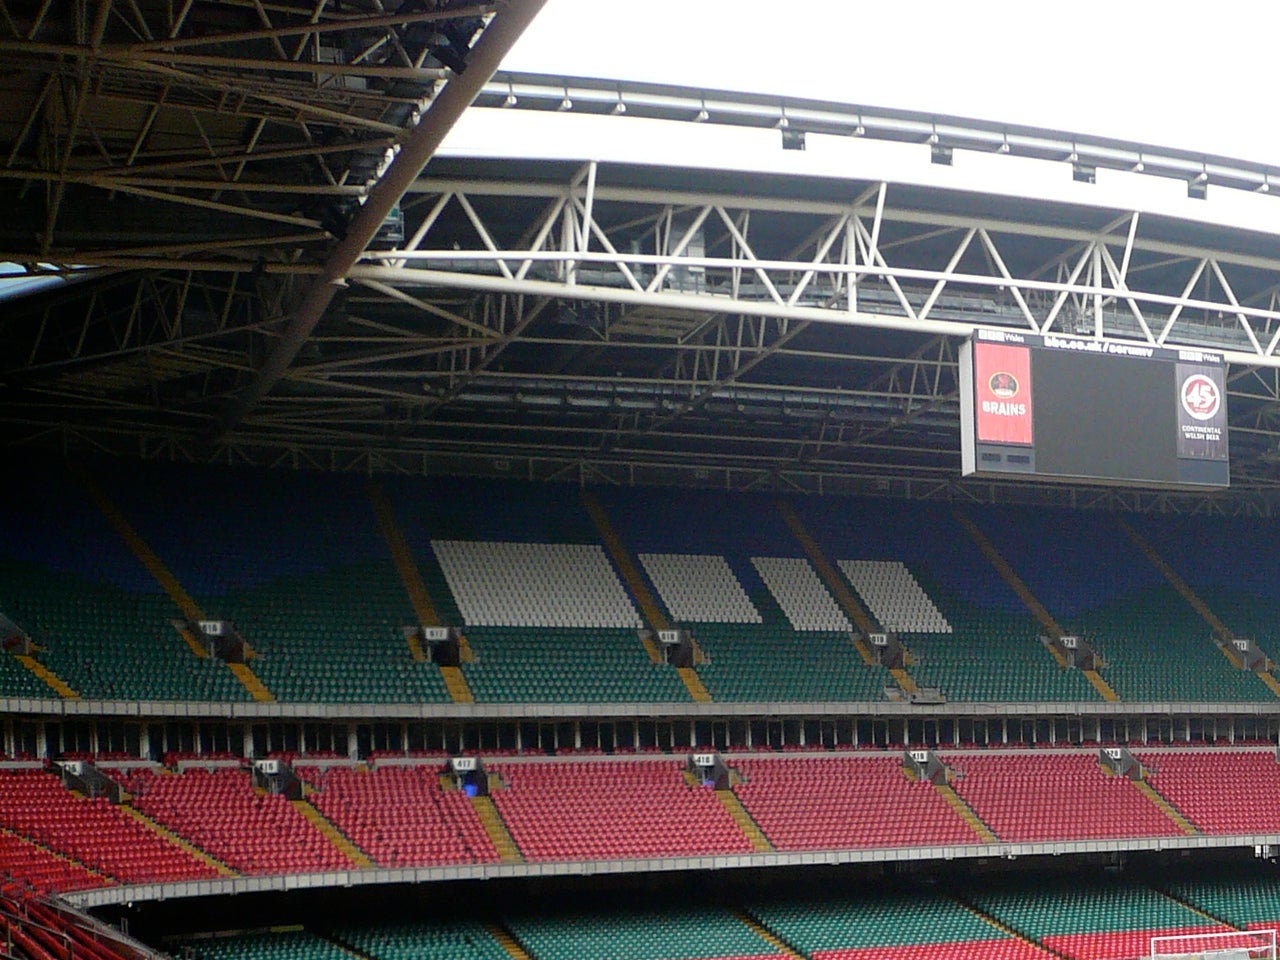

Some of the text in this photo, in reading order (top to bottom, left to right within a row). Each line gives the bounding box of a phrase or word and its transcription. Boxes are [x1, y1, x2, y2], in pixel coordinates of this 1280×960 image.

[982, 401, 1027, 417] BRAINS
[1182, 425, 1222, 435] CONTINENTAL
[1185, 433, 1205, 441] WELSH
